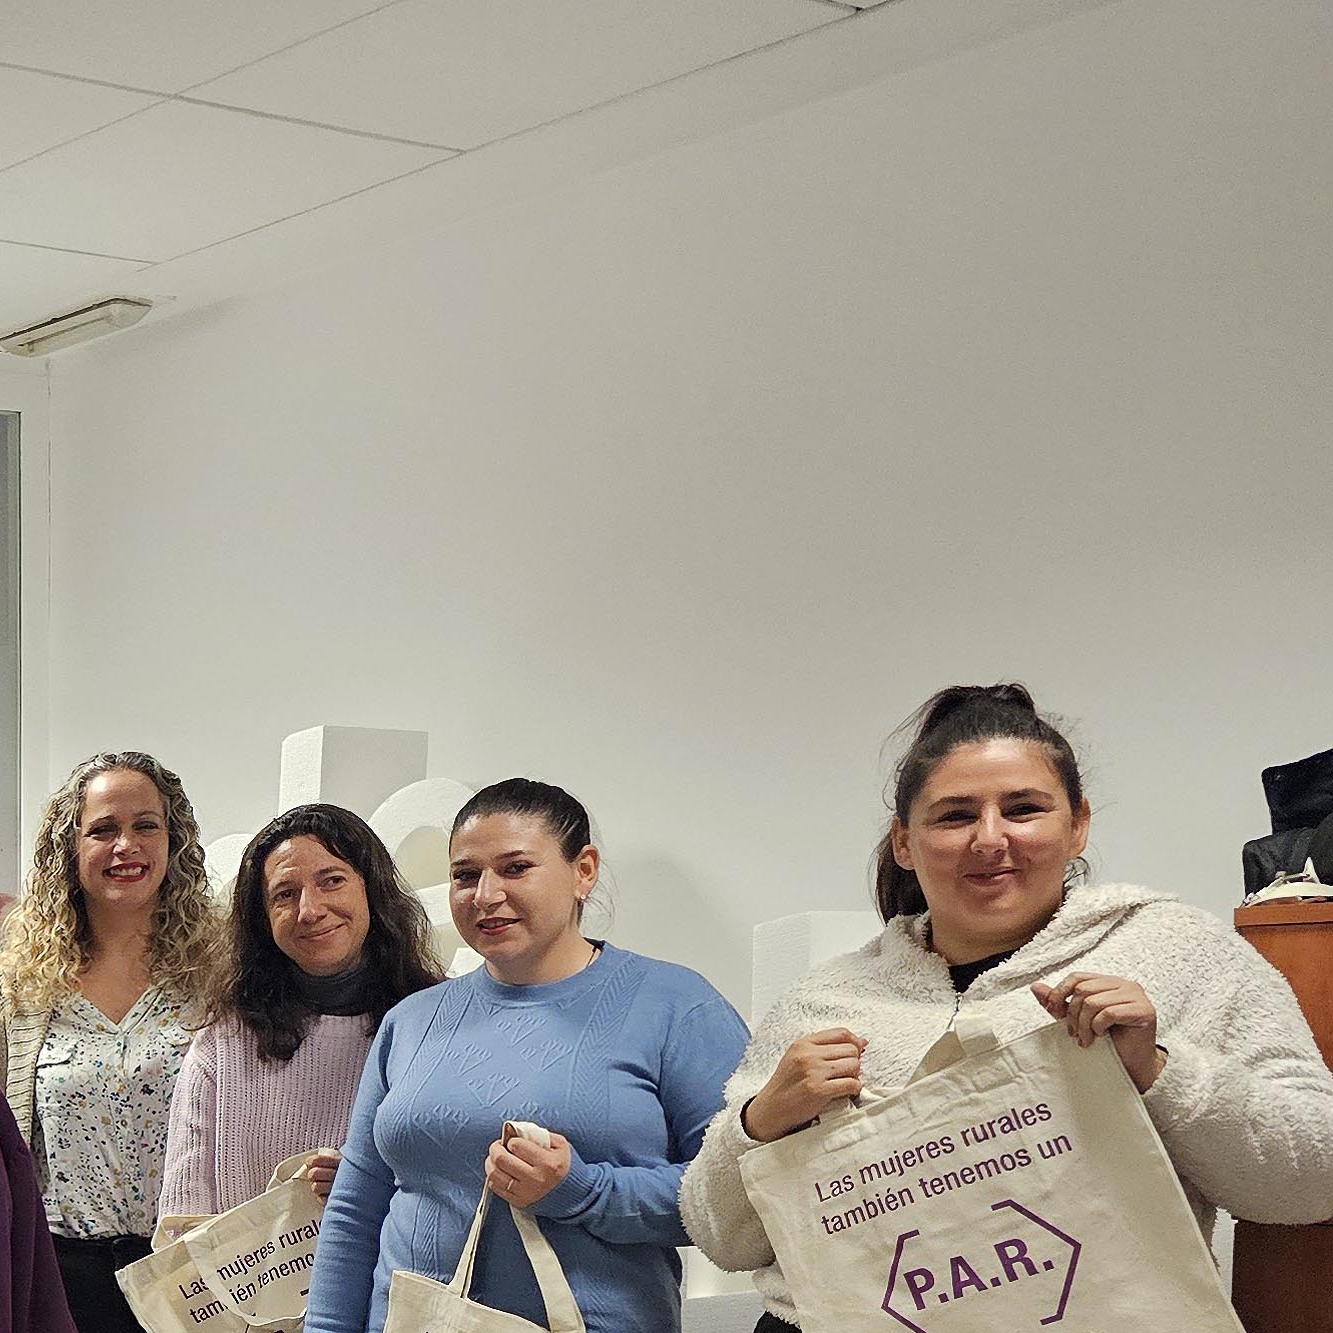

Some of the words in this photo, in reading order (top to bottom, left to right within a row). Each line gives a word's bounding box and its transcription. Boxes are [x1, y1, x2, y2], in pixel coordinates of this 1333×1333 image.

[815, 1172, 856, 1203] Las
[858, 1131, 957, 1186] mujeres
[959, 1101, 1053, 1148] rurales
[820, 1185, 916, 1236] también
[918, 1149, 1033, 1200] tenemos
[1037, 1132, 1074, 1163] un
[257, 1252, 314, 1290] tenemo
[903, 1237, 1055, 1312] P.A.R.
